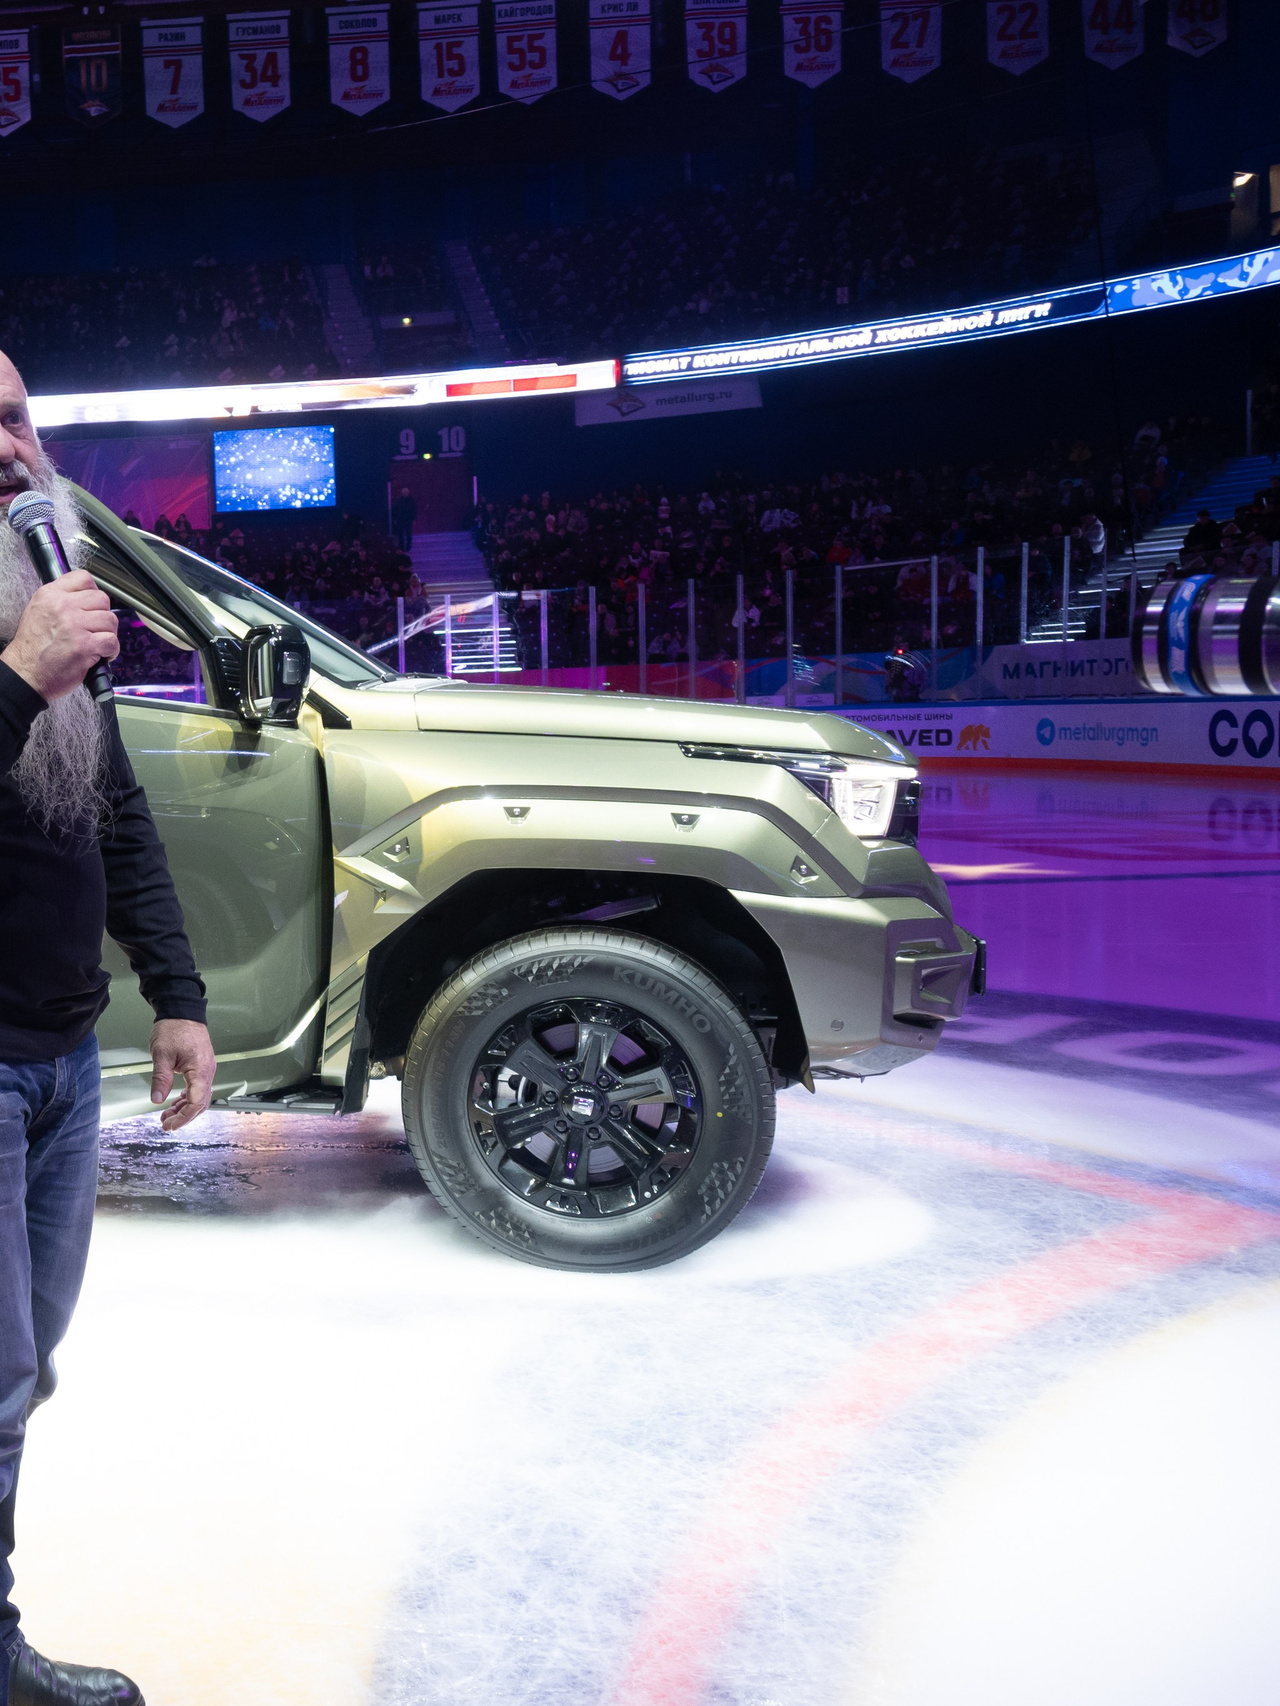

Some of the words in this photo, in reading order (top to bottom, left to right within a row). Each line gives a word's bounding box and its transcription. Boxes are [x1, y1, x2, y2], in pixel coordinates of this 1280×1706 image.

[339, 18, 378, 30] СОКОЛОВ
[434, 13, 463, 25] МАРЕК
[498, 4, 554, 18] КАЙГОРОДОВ
[601, 3, 624, 14] КРИС
[625, 2, 639, 12] ЛИ
[996, 2, 1039, 42] 22
[158, 32, 186, 42] РАЗИН
[236, 24, 281, 36] ГУСМАНОВ
[609, 29, 632, 66] 4
[696, 21, 737, 58] 39
[793, 15, 833, 54] 36
[890, 11, 930, 49] 27
[350, 46, 369, 82] 8
[434, 41, 466, 78] 15
[506, 32, 547, 72] 55
[80, 57, 108, 93] 10
[163, 59, 182, 95] 7
[238, 52, 281, 90] 34
[692, 329, 872, 368] КОНТИНЕНТАЛЬНОЙ
[874, 311, 994, 344] ХОККЕЙНОЙ
[655, 390, 732, 407] metallurg.ru
[400, 428, 415, 454] 9
[438, 426, 466, 452] 10
[1058, 722, 1158, 746] metallurgmgn
[613, 966, 711, 1033] KUMHO
